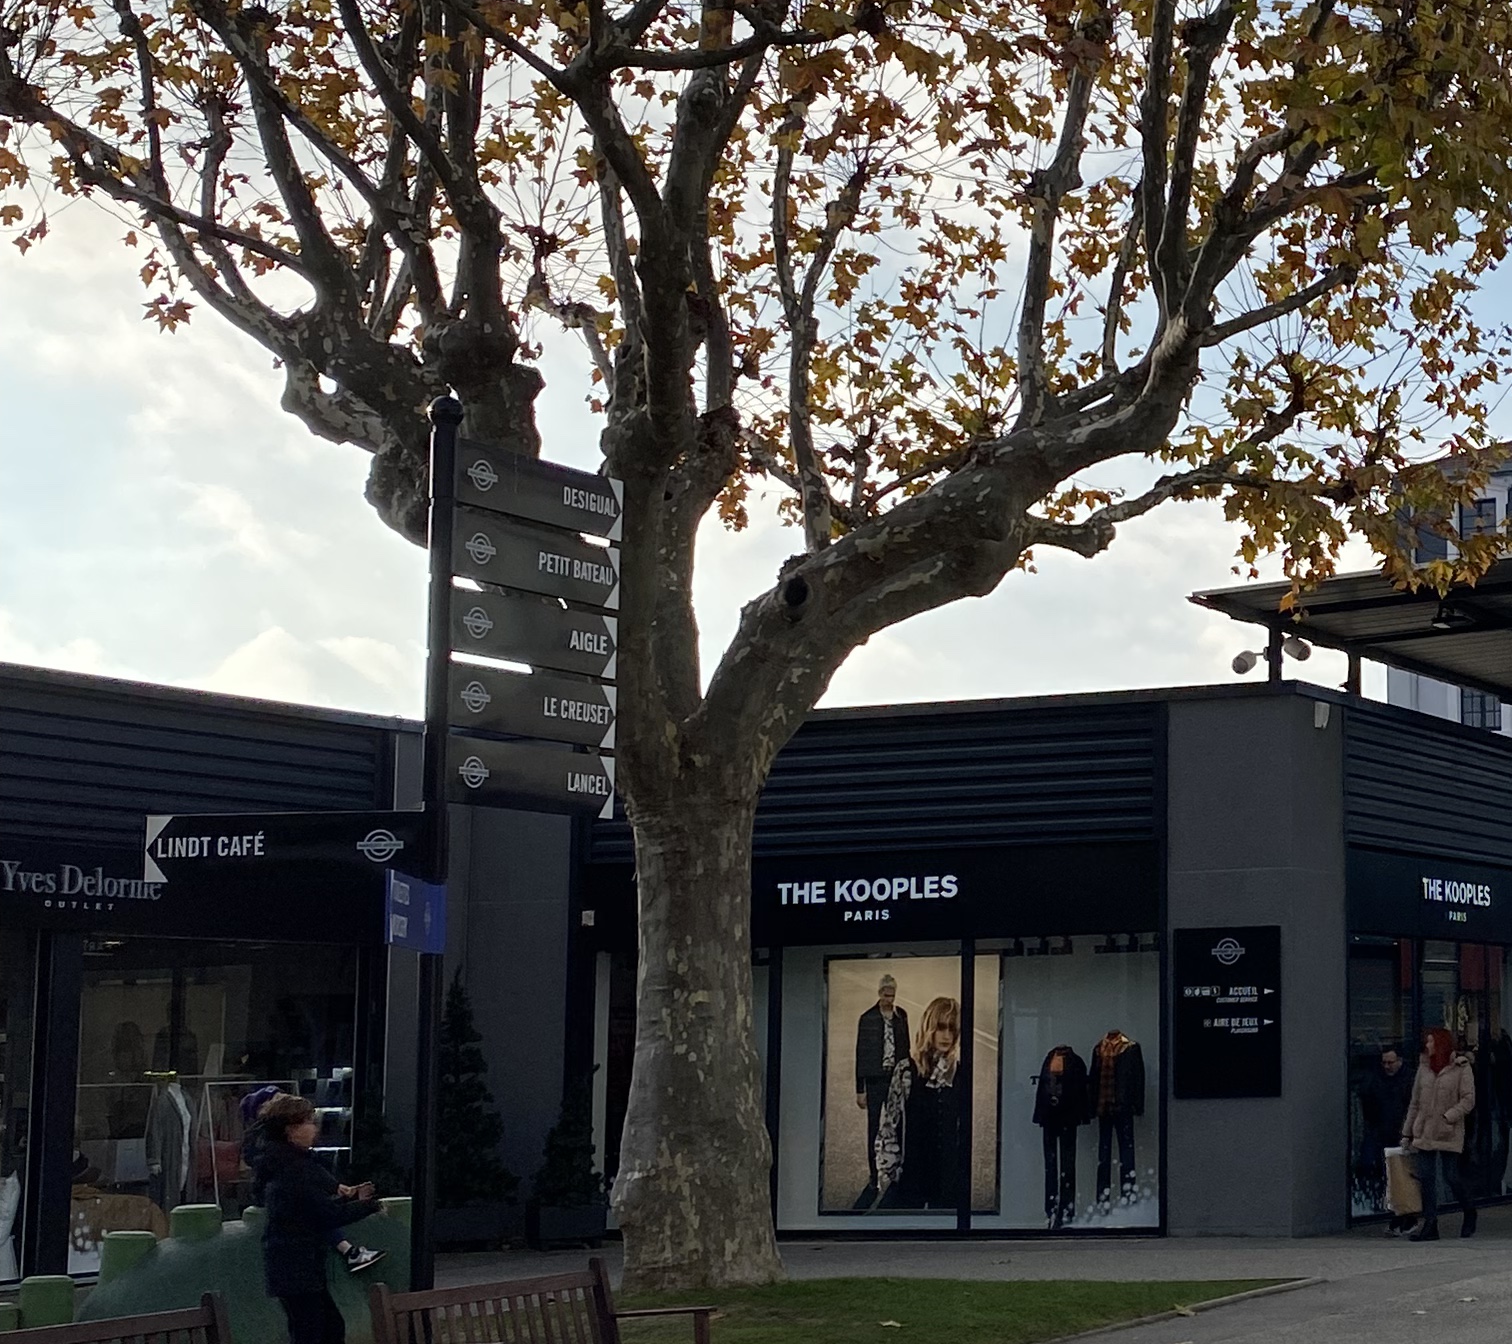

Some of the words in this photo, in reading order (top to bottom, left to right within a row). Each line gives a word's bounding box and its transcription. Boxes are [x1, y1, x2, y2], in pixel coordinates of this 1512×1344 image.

[563, 485, 618, 518] DESIGUAL
[538, 551, 571, 576] PETIT
[573, 559, 614, 587] BATEAU
[569, 630, 608, 655] AIGLE
[543, 696, 558, 717] LE
[560, 699, 611, 726] CREUSET
[567, 771, 609, 797] LANCEL
[156, 836, 212, 858] LINDT
[217, 830, 265, 856] CAFÉ
[0, 859, 57, 894] Yves
[60, 863, 163, 901] Delorme
[777, 880, 827, 905] THE
[834, 874, 959, 903] KOOPLES
[1422, 877, 1443, 901] THE
[1444, 880, 1491, 907] KOOPLES
[44, 899, 115, 911] OUTLET
[843, 908, 890, 922] PARIS
[1449, 910, 1468, 923] PARIS
